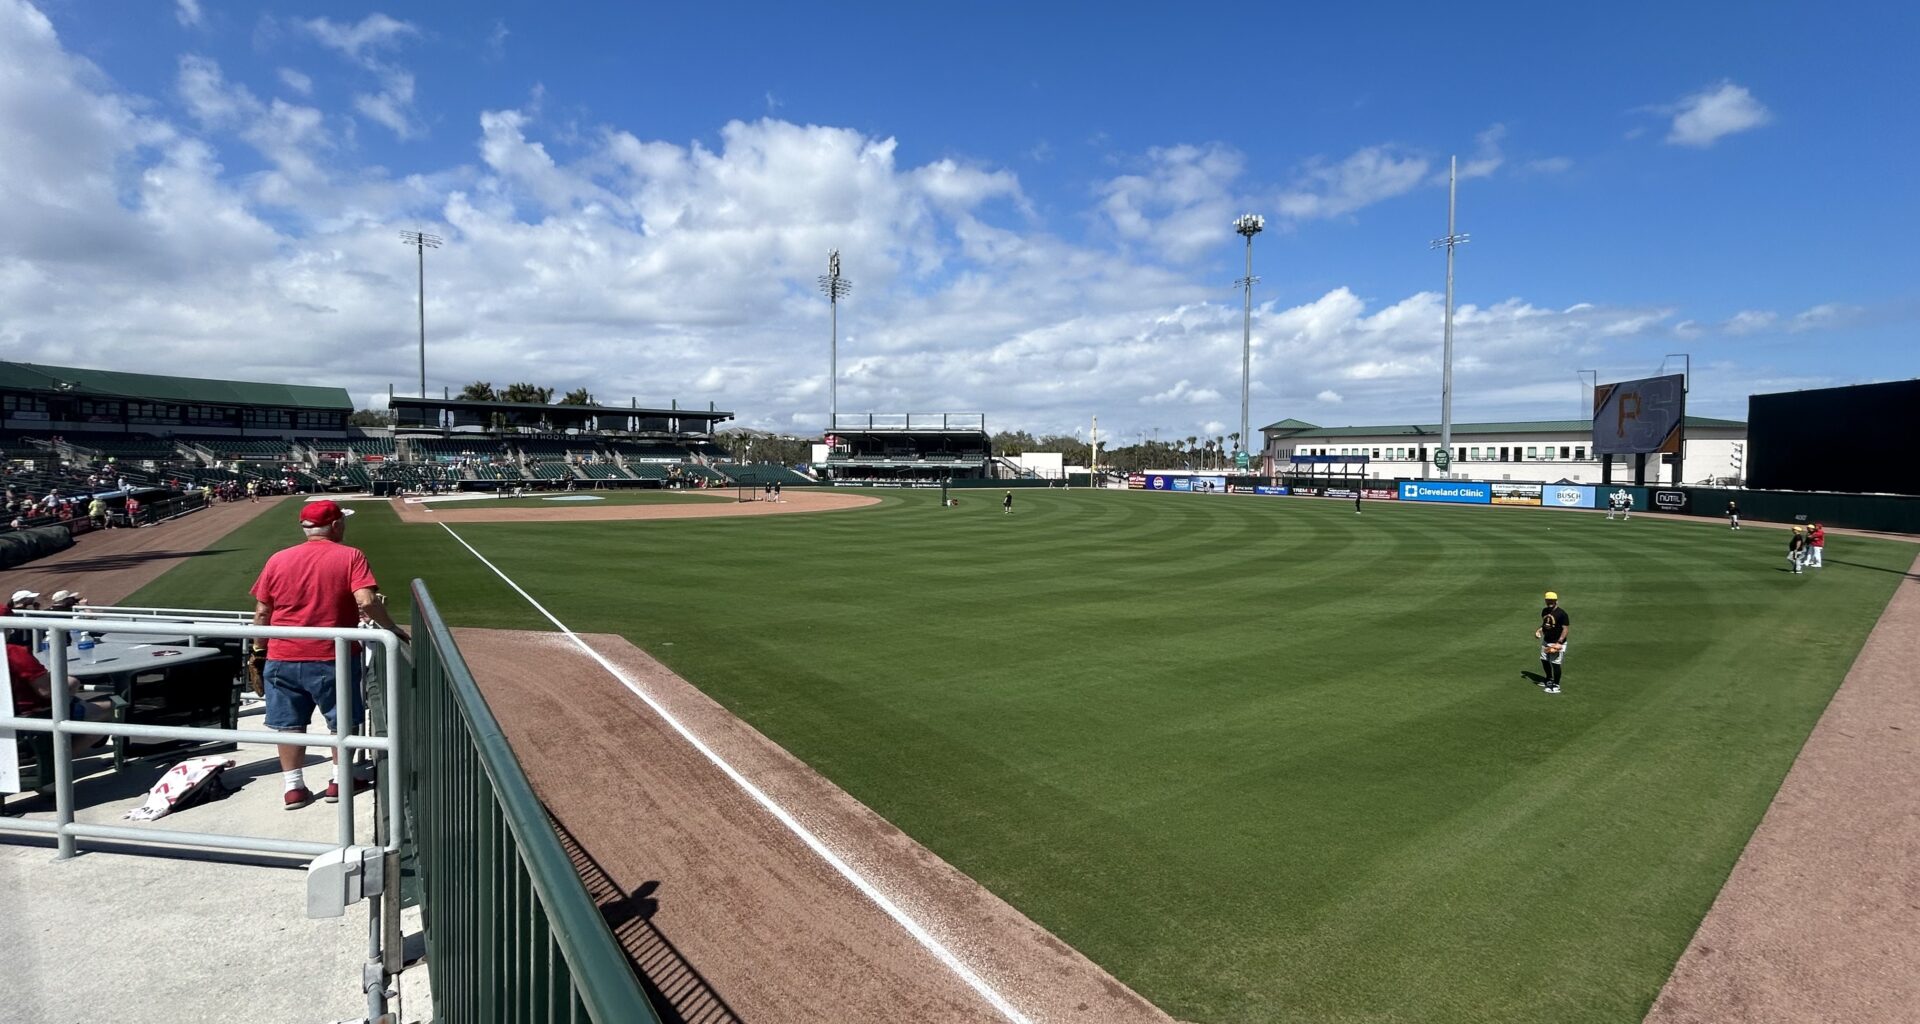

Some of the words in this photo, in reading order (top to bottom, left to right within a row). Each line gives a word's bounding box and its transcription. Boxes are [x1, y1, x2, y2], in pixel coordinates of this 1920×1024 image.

[1418, 487, 1458, 497] Cleveland
[1459, 488, 1484, 498] Clinic
[1556, 491, 1581, 499] BUSCH
